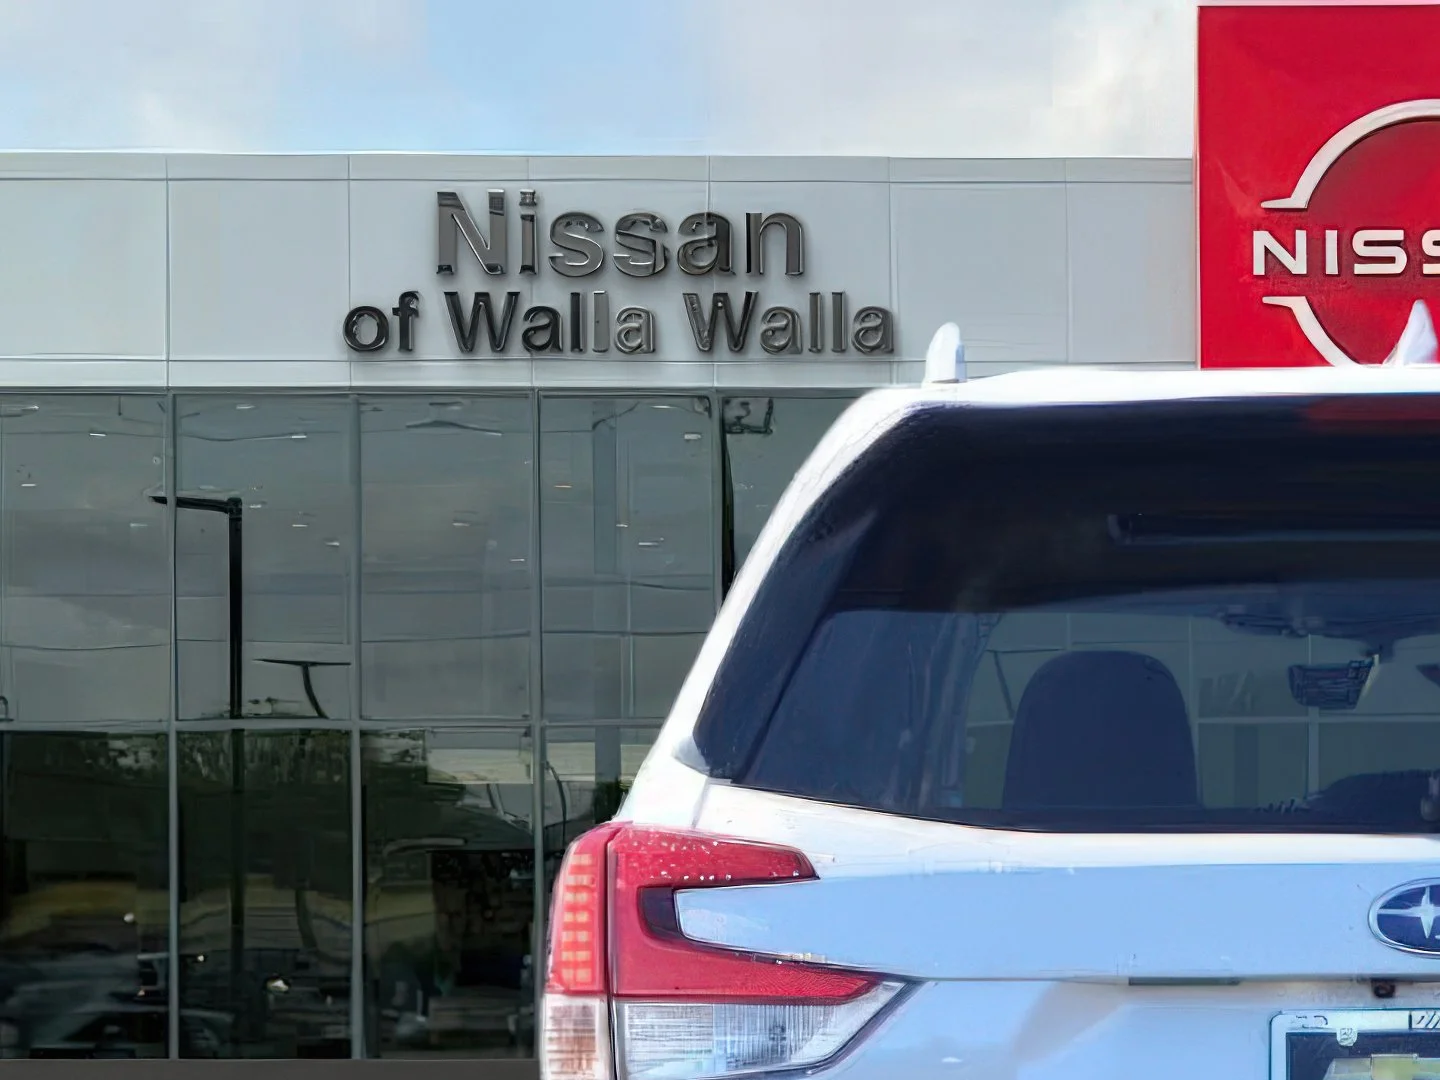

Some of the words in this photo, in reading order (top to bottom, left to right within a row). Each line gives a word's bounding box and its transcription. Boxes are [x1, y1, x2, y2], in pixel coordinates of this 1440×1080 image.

[435, 188, 805, 277] Nissan
[342, 290, 421, 352] of
[444, 290, 657, 354] Walla
[682, 290, 896, 354] Walla
